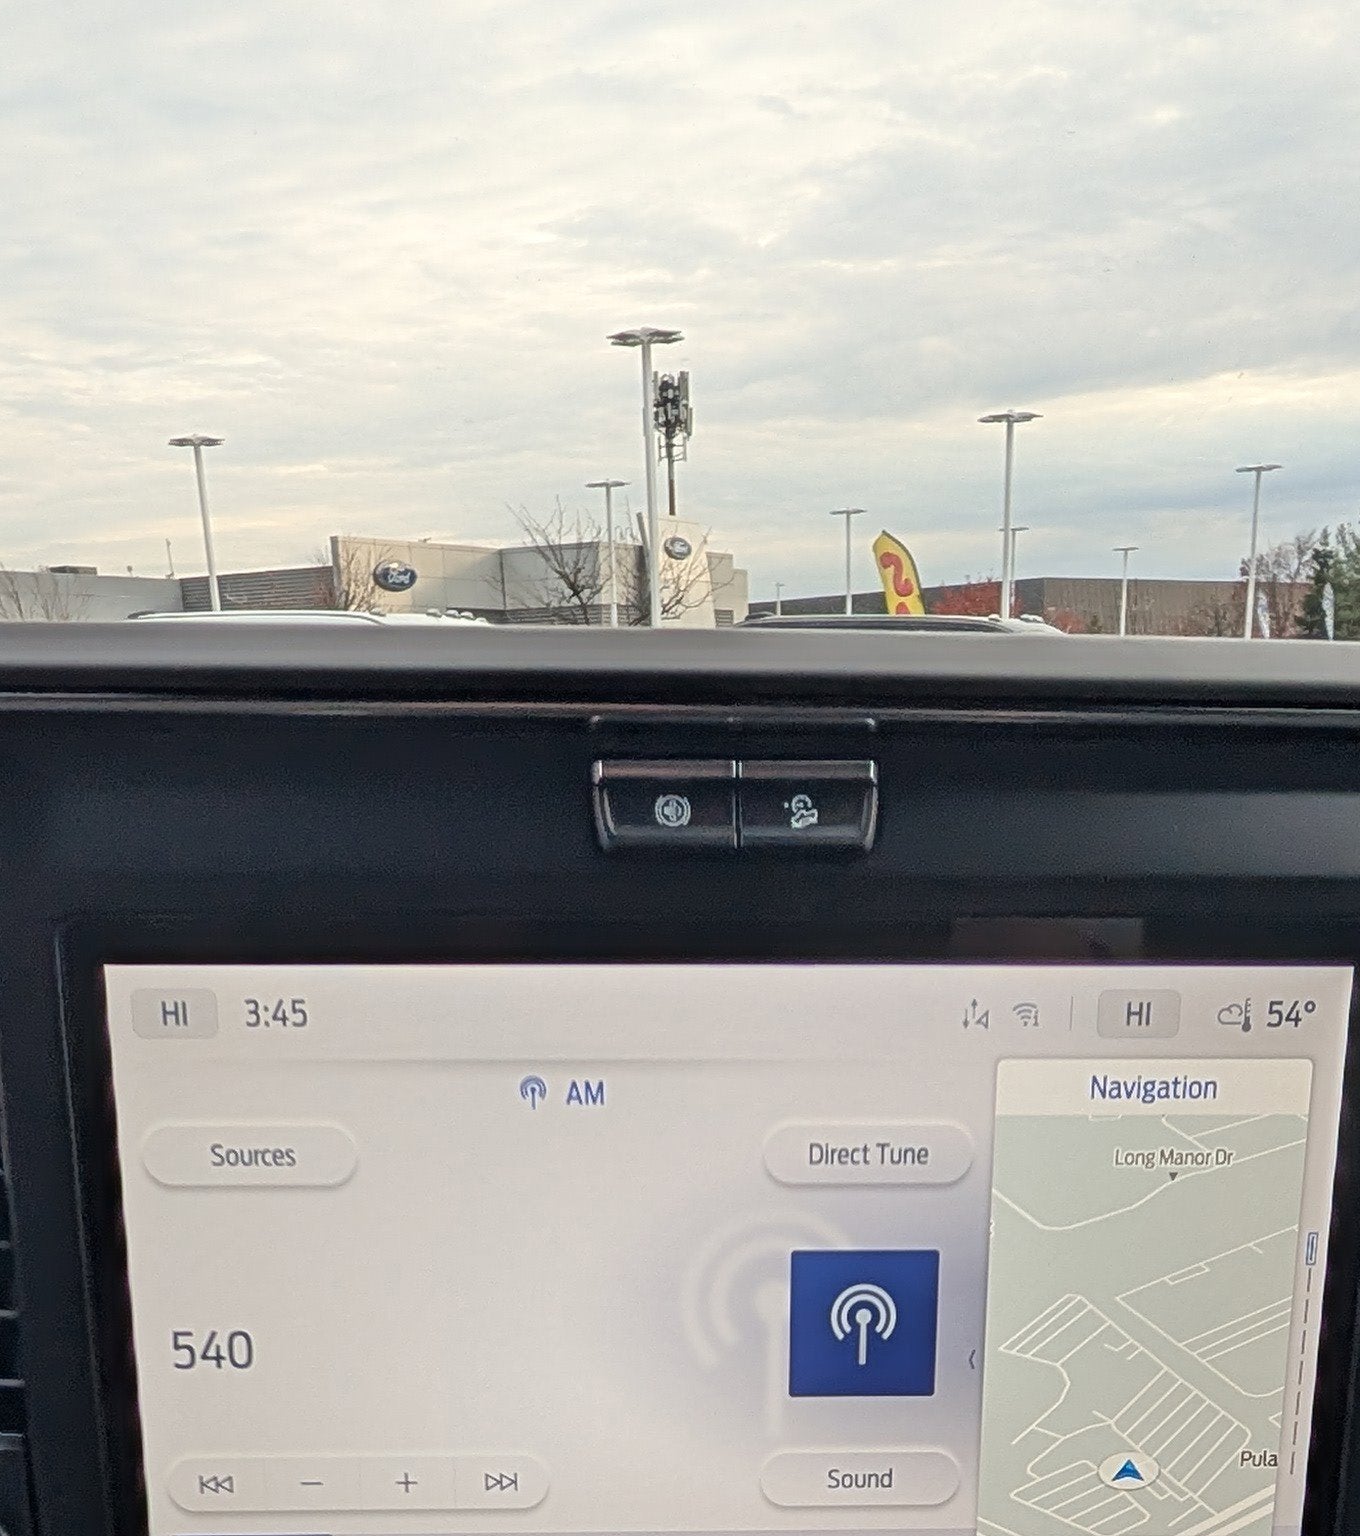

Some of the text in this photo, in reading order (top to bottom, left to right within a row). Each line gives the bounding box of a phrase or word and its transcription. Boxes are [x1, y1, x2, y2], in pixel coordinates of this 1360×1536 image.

[161, 999, 309, 1028] HI 3:45
[1125, 1000, 1316, 1027] HI 54°
[566, 1080, 605, 1106] AM
[1091, 1074, 1218, 1104] Navigation
[210, 1143, 297, 1169] Sources
[808, 1142, 929, 1166] Direct Tune
[1114, 1147, 1234, 1171] Long Manor Dr
[171, 1330, 254, 1371] 540
[1239, 1450, 1278, 1468] Pula
[826, 1468, 894, 1490] Sound
